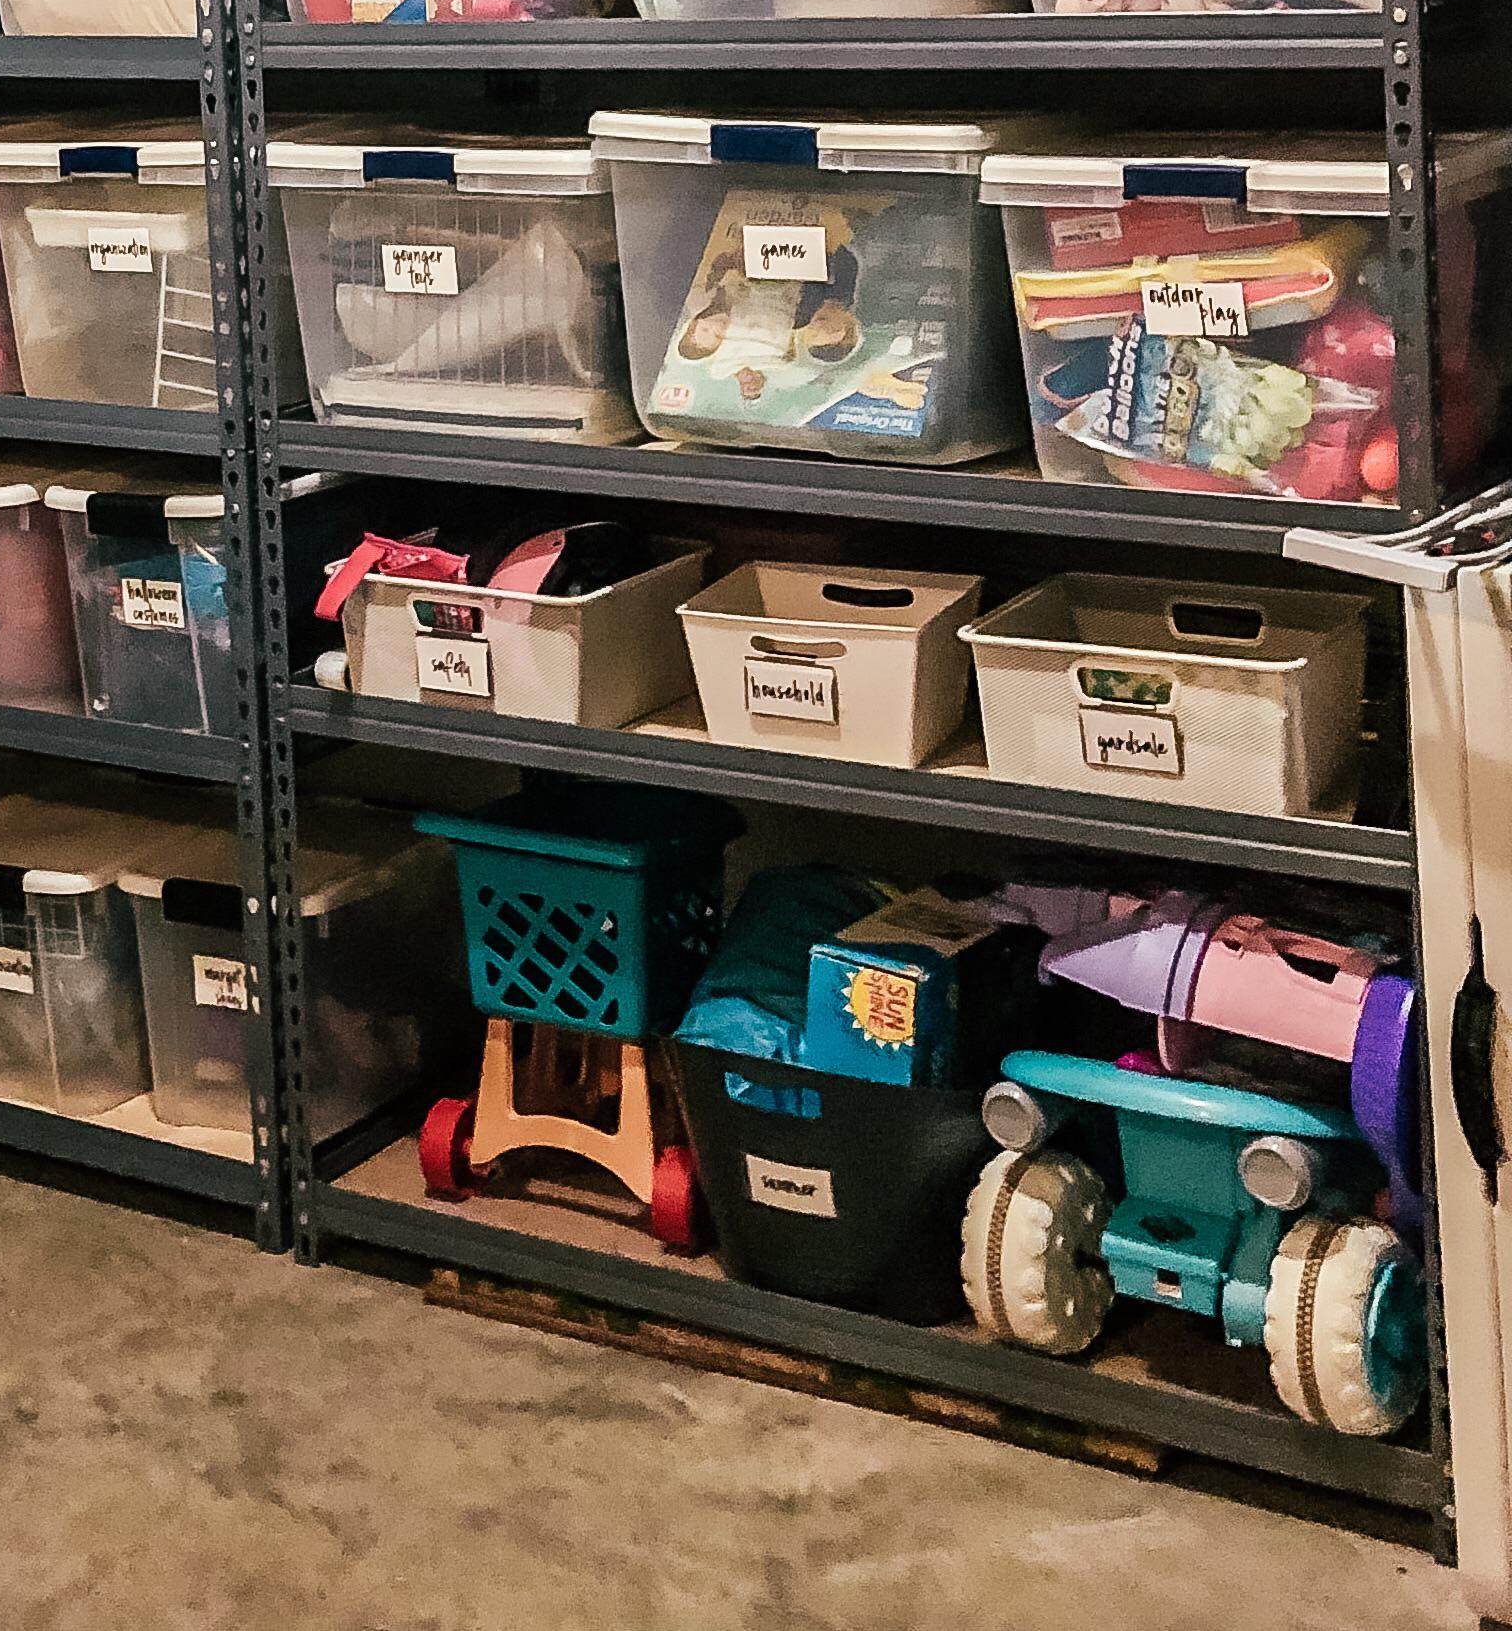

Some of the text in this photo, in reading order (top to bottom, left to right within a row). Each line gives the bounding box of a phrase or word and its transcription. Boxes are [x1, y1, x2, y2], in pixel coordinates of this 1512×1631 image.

[89, 237, 149, 266] organization
[392, 249, 443, 276] younger
[760, 243, 807, 272] games
[407, 269, 434, 294] toys
[1148, 284, 1204, 308] outdoor
[1198, 296, 1240, 336] play
[431, 651, 473, 687] safety
[750, 675, 825, 708] household
[866, 971, 888, 1029] SHINE
[889, 985, 909, 1032] SUN
